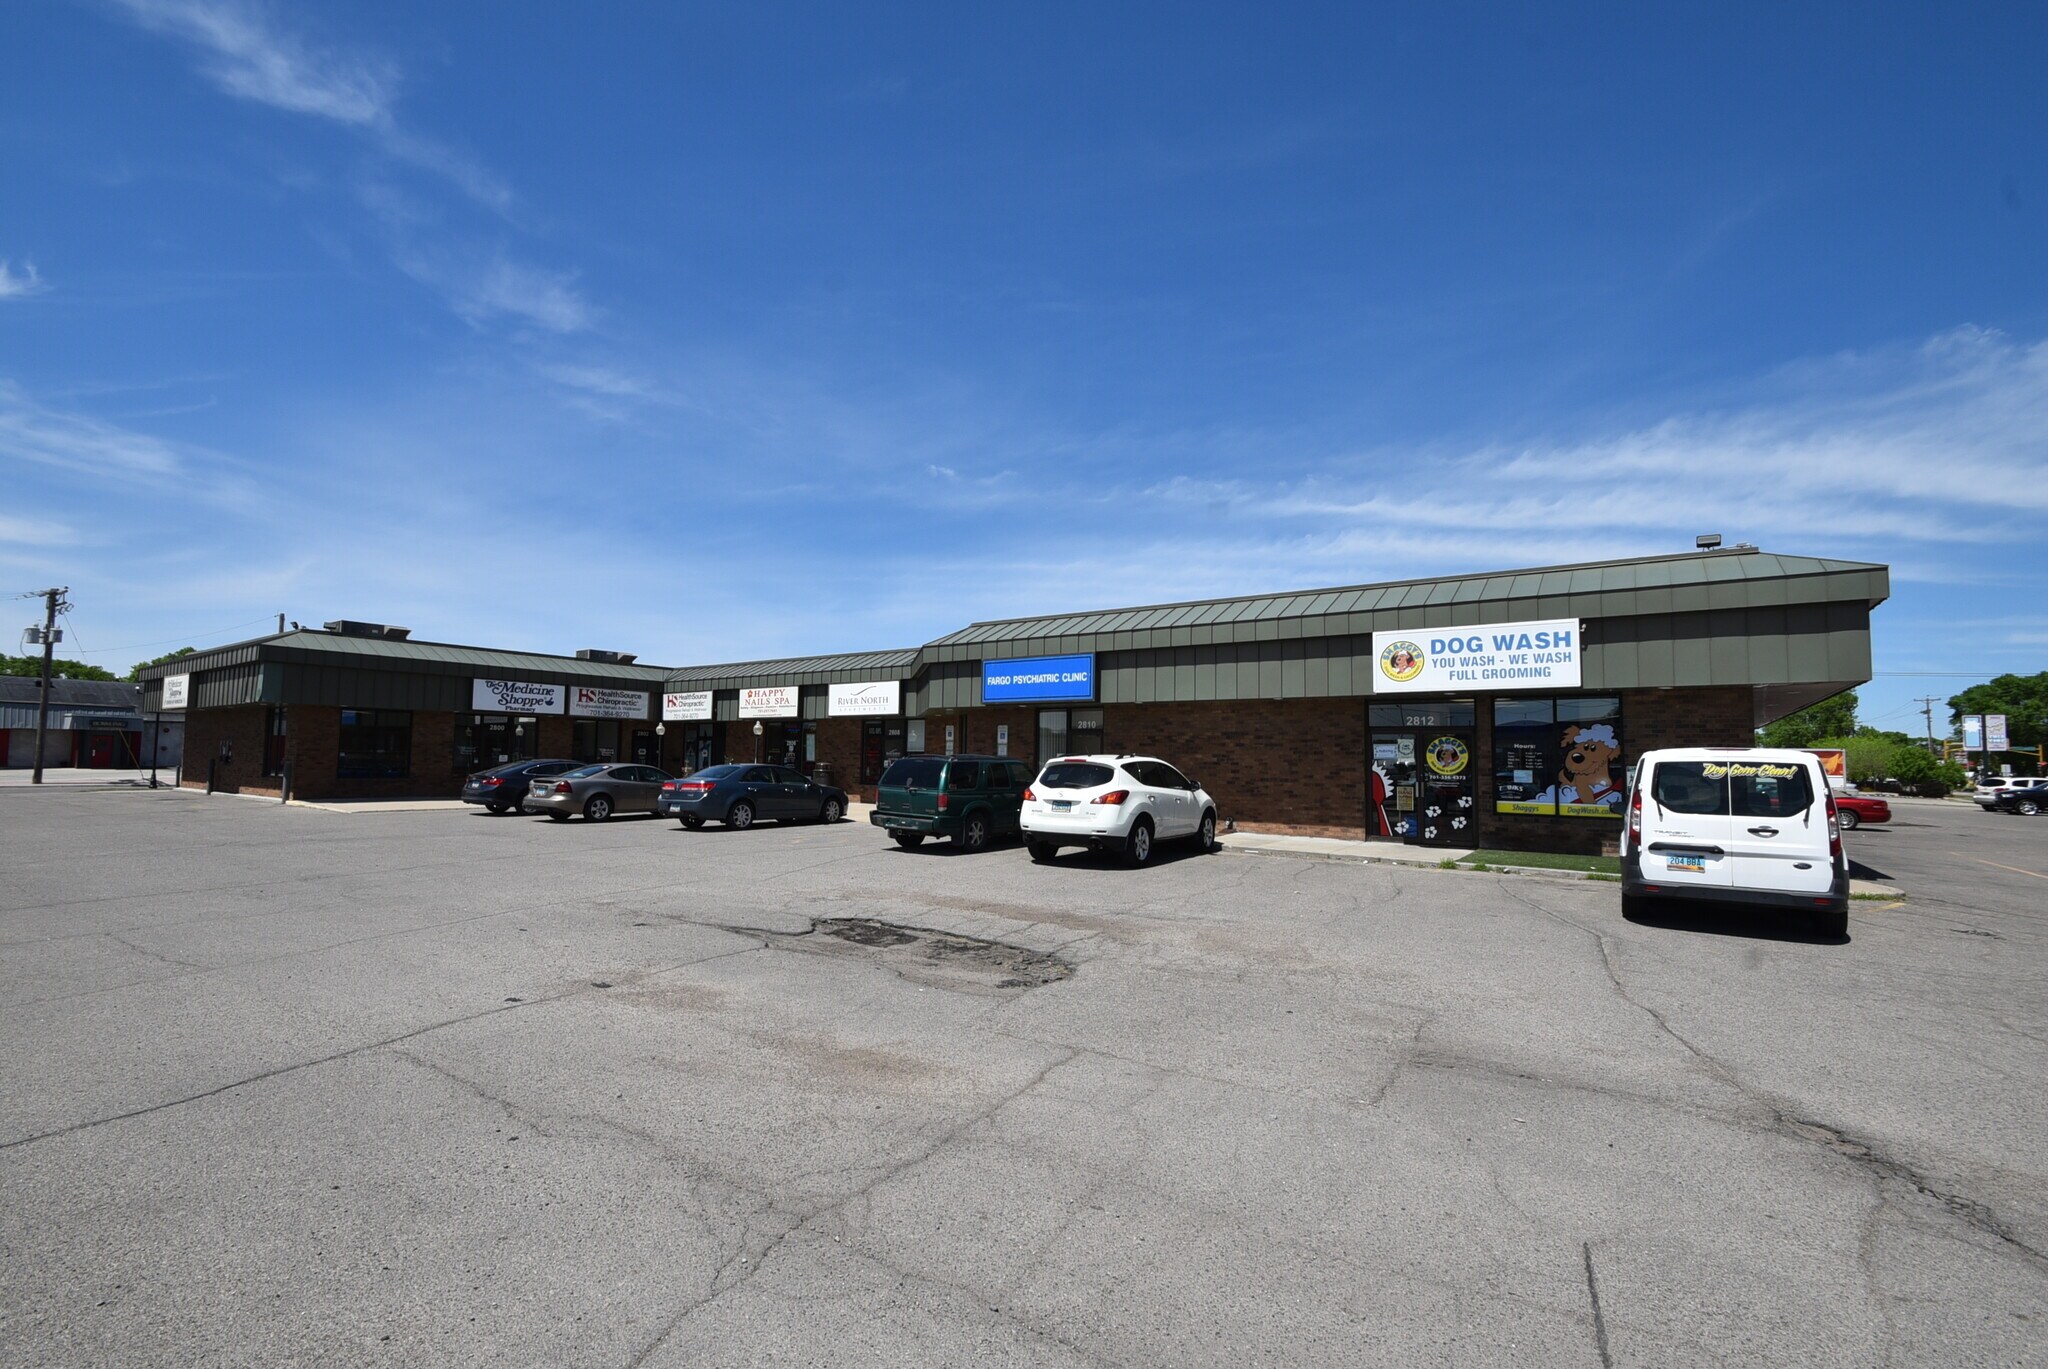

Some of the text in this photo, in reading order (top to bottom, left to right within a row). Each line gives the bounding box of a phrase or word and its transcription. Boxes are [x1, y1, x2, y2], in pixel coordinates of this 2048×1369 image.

[1430, 631, 1572, 655] DOG WASH
[1383, 642, 1422, 660] SHAGGY'S
[1431, 657, 1456, 669] YOU
[1459, 655, 1495, 667] WASH
[1508, 654, 1528, 665] WE
[1532, 652, 1572, 664] WASH
[987, 672, 1088, 686] FARGO PSYCHIATRIC CLINIC
[1449, 666, 1551, 681] FULL GROOMING
[492, 681, 555, 696] Medicine
[754, 689, 785, 698] HAPPY
[498, 693, 544, 707] Shoppe
[598, 690, 642, 700] HealthSource
[838, 696, 889, 705] RIVER NORTH
[597, 697, 637, 706] Chiropractic
[745, 697, 790, 706] NAILS SPA
[1078, 721, 1096, 729] 2810
[1406, 716, 1435, 726] 2812
[1427, 738, 1467, 754] SHAGGY'S
[1703, 763, 1798, 780] Dog Gone Clean!
[1512, 804, 1539, 812] Shaggys
[1670, 857, 1701, 866] 204 BBA
